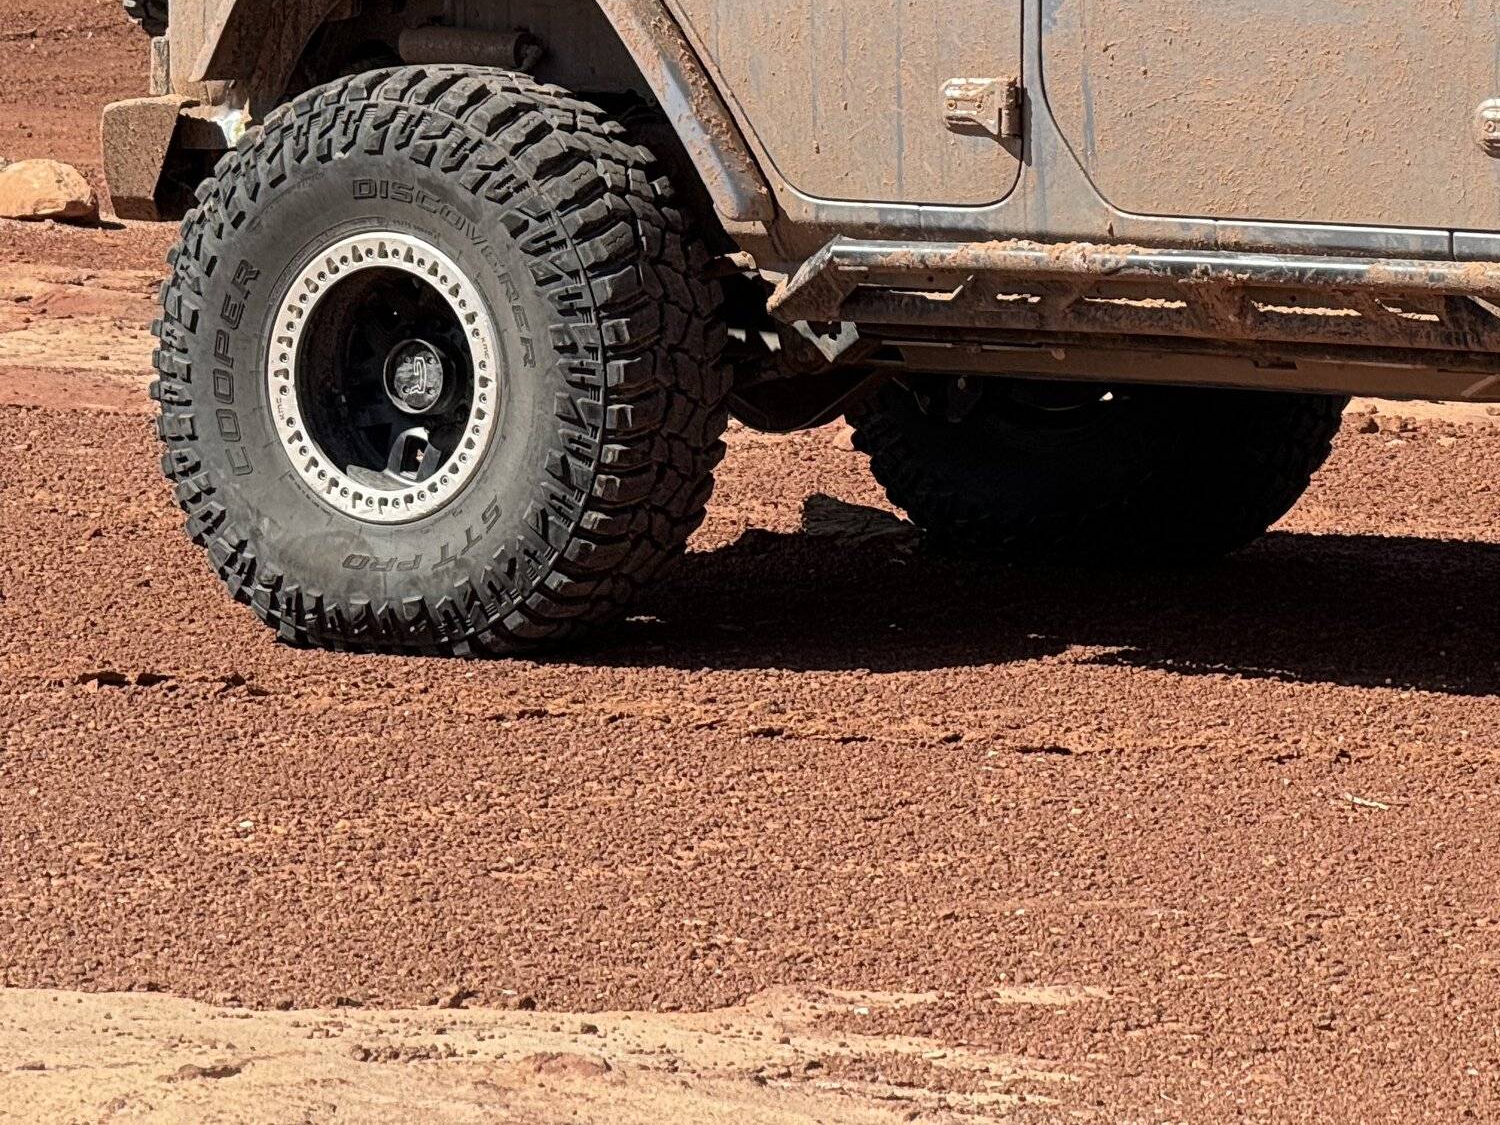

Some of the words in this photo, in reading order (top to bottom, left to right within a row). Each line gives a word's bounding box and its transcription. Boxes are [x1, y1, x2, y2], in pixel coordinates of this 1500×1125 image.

[352, 178, 537, 368] DISCOVERER
[212, 259, 261, 476] COOPER
[342, 553, 423, 572] PRO
[431, 494, 503, 571] STT
